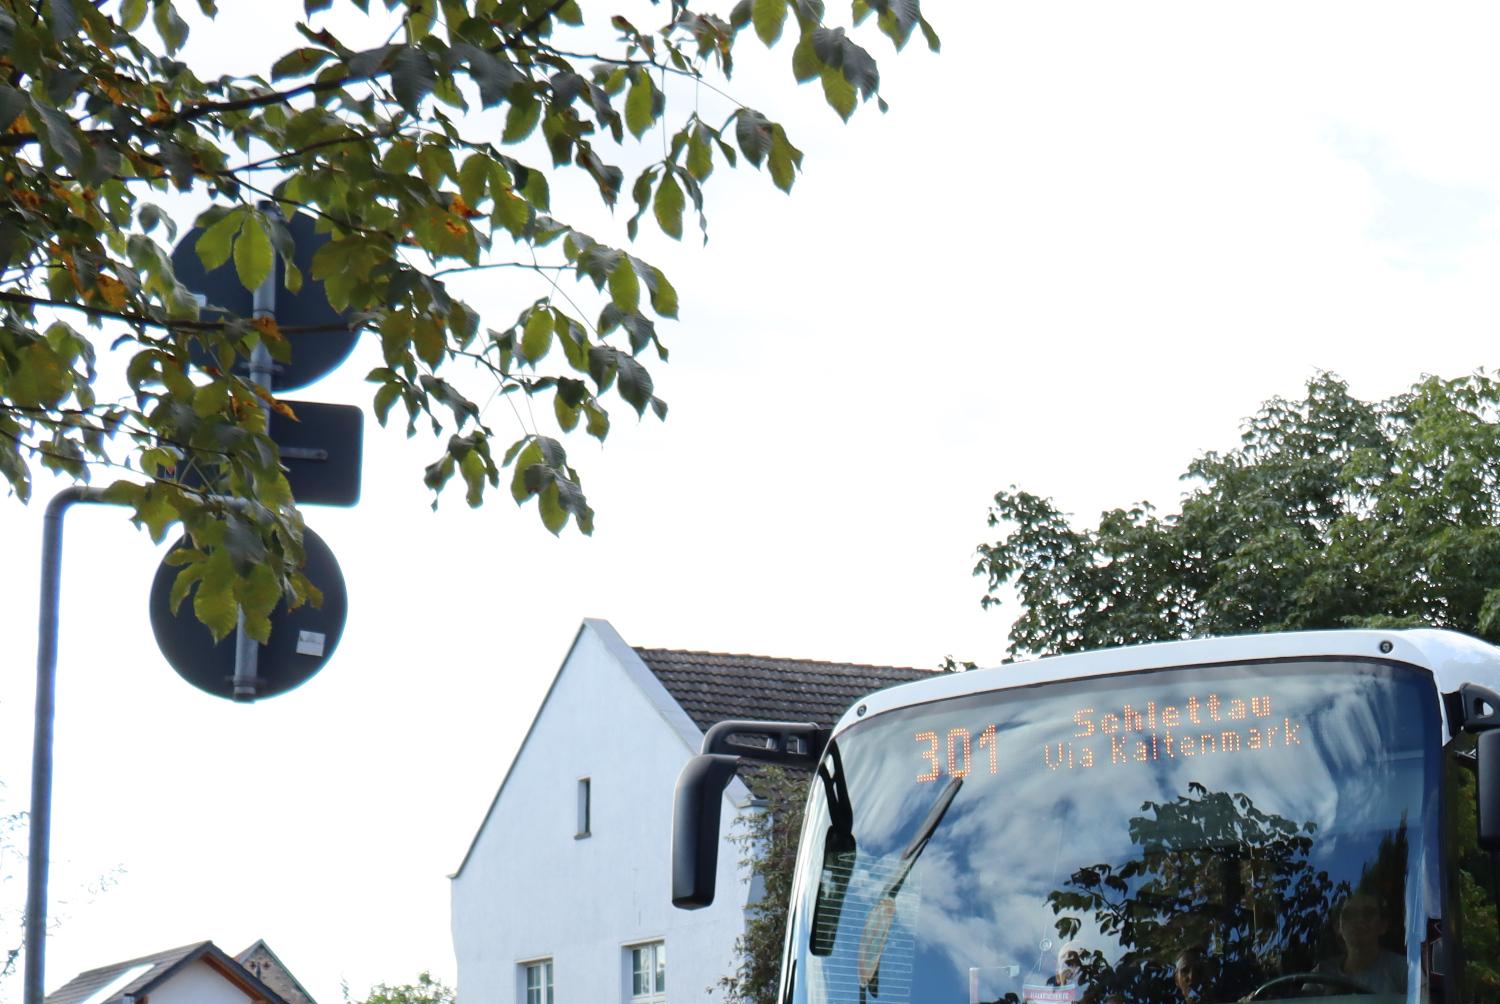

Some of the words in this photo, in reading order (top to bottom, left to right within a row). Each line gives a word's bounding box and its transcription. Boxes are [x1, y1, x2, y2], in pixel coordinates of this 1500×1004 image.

[1073, 694, 1273, 738] Schlettau
[914, 724, 999, 783] 301
[1111, 717, 1301, 765] Kaltenmark
